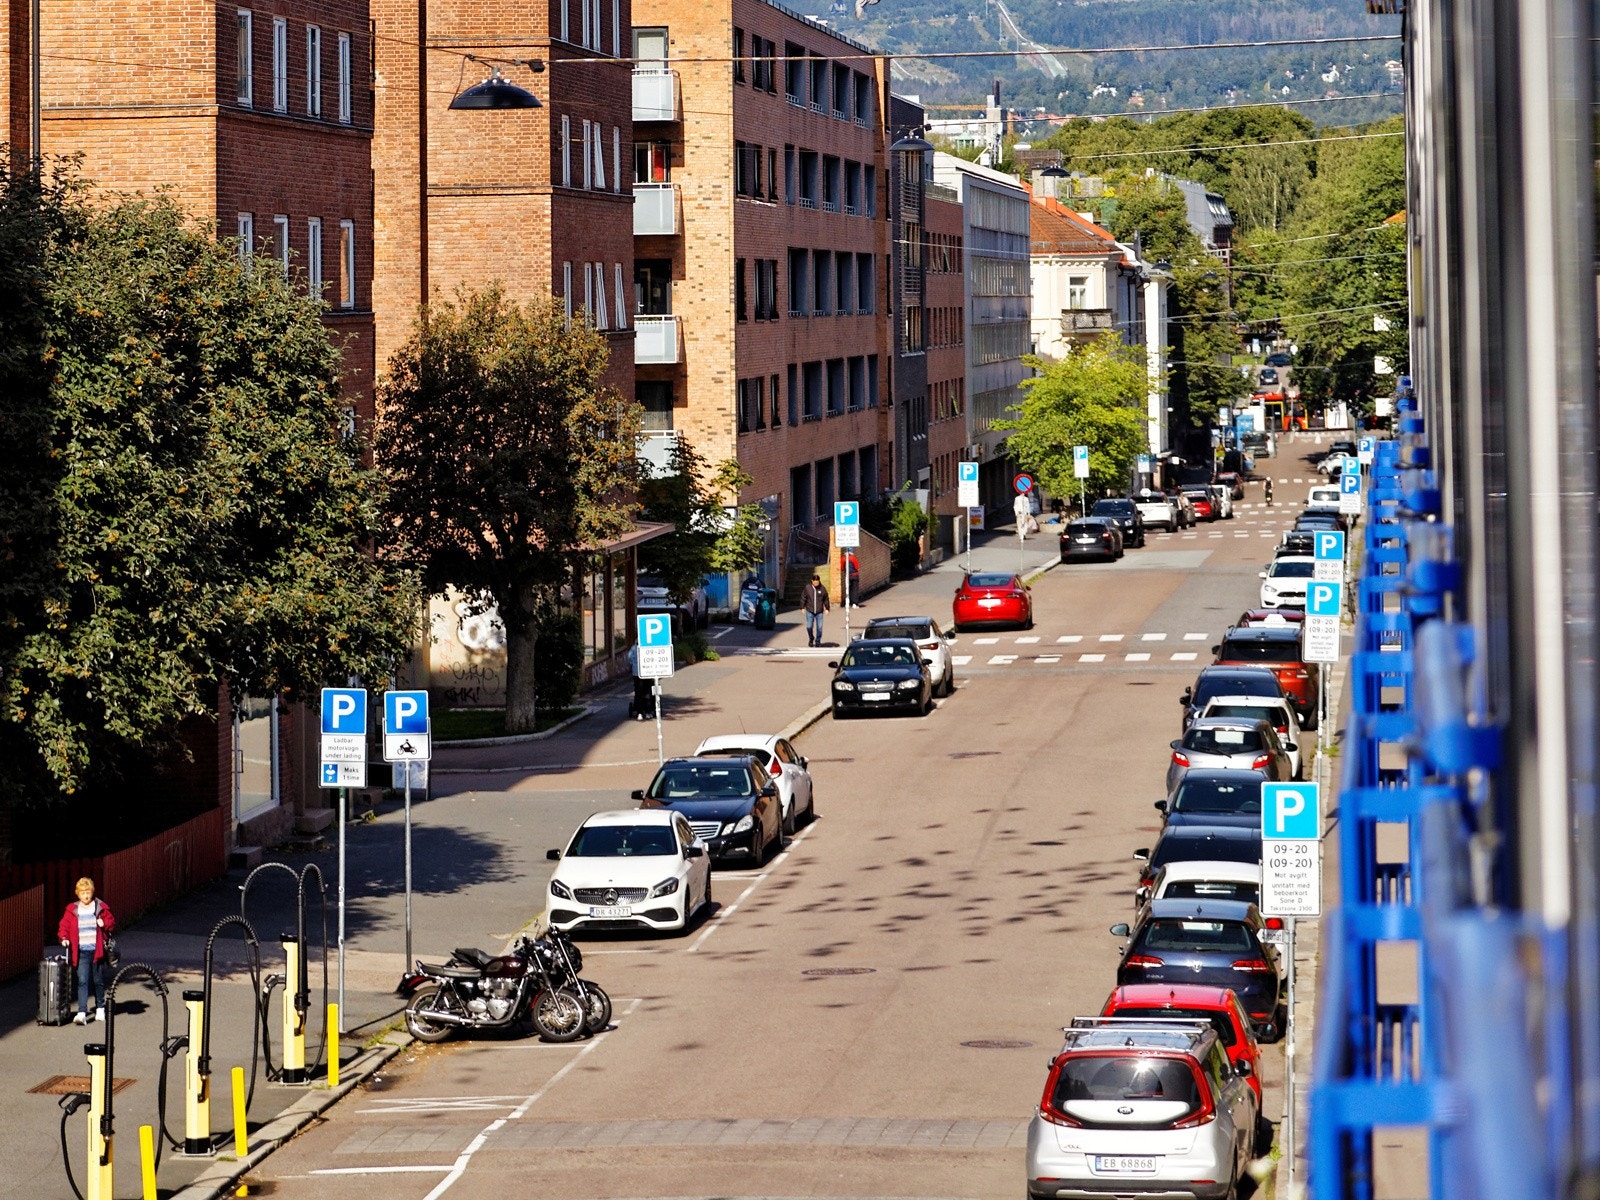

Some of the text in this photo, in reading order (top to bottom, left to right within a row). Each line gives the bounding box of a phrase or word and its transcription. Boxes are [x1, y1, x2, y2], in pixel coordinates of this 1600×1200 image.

[1078, 448, 1085, 459] P
[1360, 441, 1368, 451] P
[963, 465, 974, 480] P
[1346, 460, 1356, 473] P
[1345, 477, 1357, 492] P
[840, 505, 853, 523] P
[1322, 534, 1337, 557] P
[1314, 586, 1333, 611] P
[645, 619, 663, 644] P
[333, 694, 355, 728] P
[396, 697, 417, 729] P
[1276, 790, 1305, 832] P
[1274, 845, 1308, 854] 09-20
[1270, 858, 1312, 868] (09-20)
[1104, 1159, 1153, 1168] EB 68868
